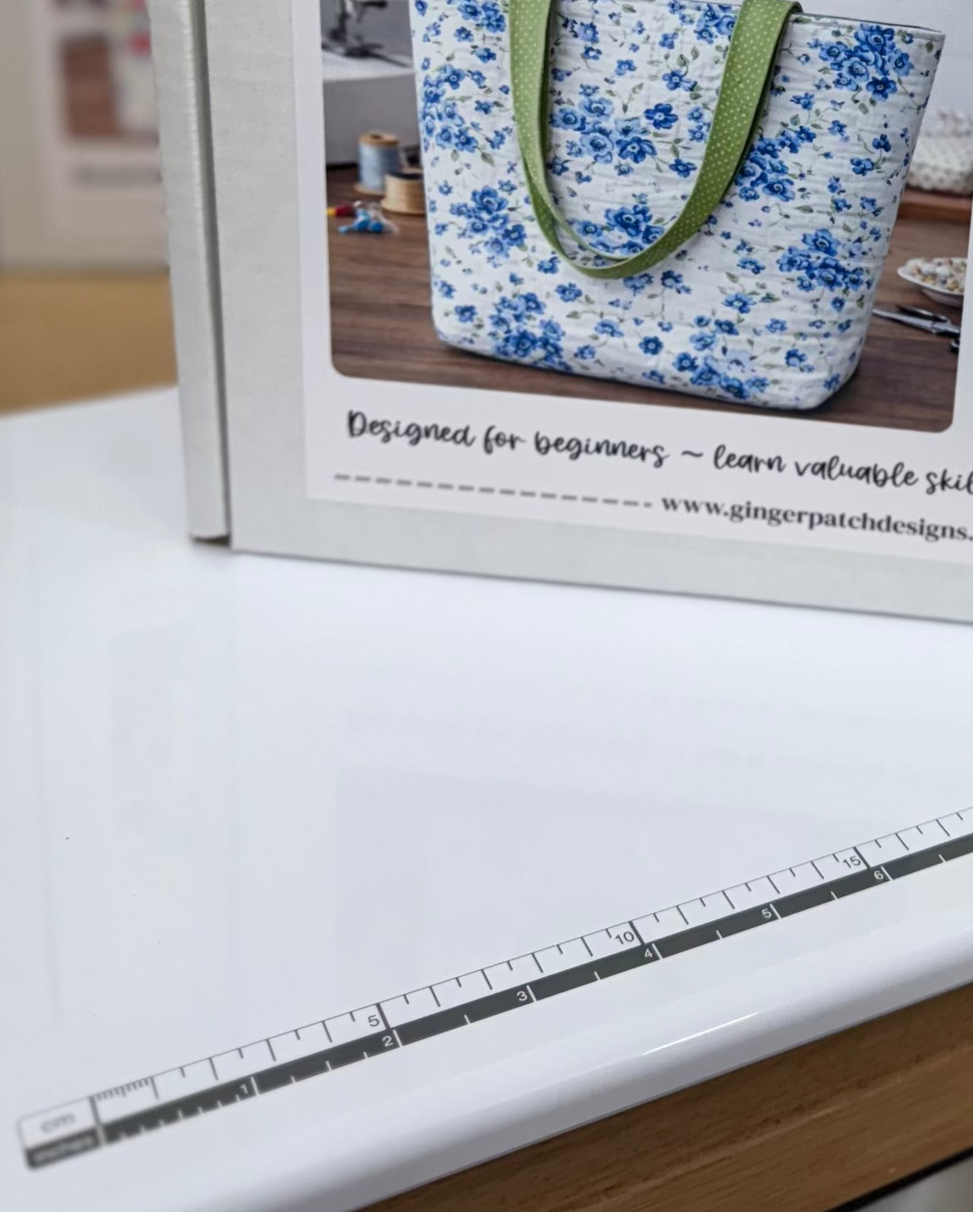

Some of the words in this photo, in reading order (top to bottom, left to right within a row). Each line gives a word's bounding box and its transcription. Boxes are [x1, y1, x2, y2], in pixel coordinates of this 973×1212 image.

[348, 410, 476, 447] Designed
[483, 425, 526, 454] for
[534, 431, 669, 468] beginners
[713, 444, 787, 473] learn
[794, 456, 919, 488] valuable
[842, 855, 861, 869] 15
[873, 870, 884, 881] 6
[761, 908, 772, 919] 5
[615, 930, 635, 945] 10
[643, 949, 653, 960] 4
[516, 990, 528, 1002] 3
[368, 1014, 380, 1028] 5
[382, 1035, 394, 1048] 2
